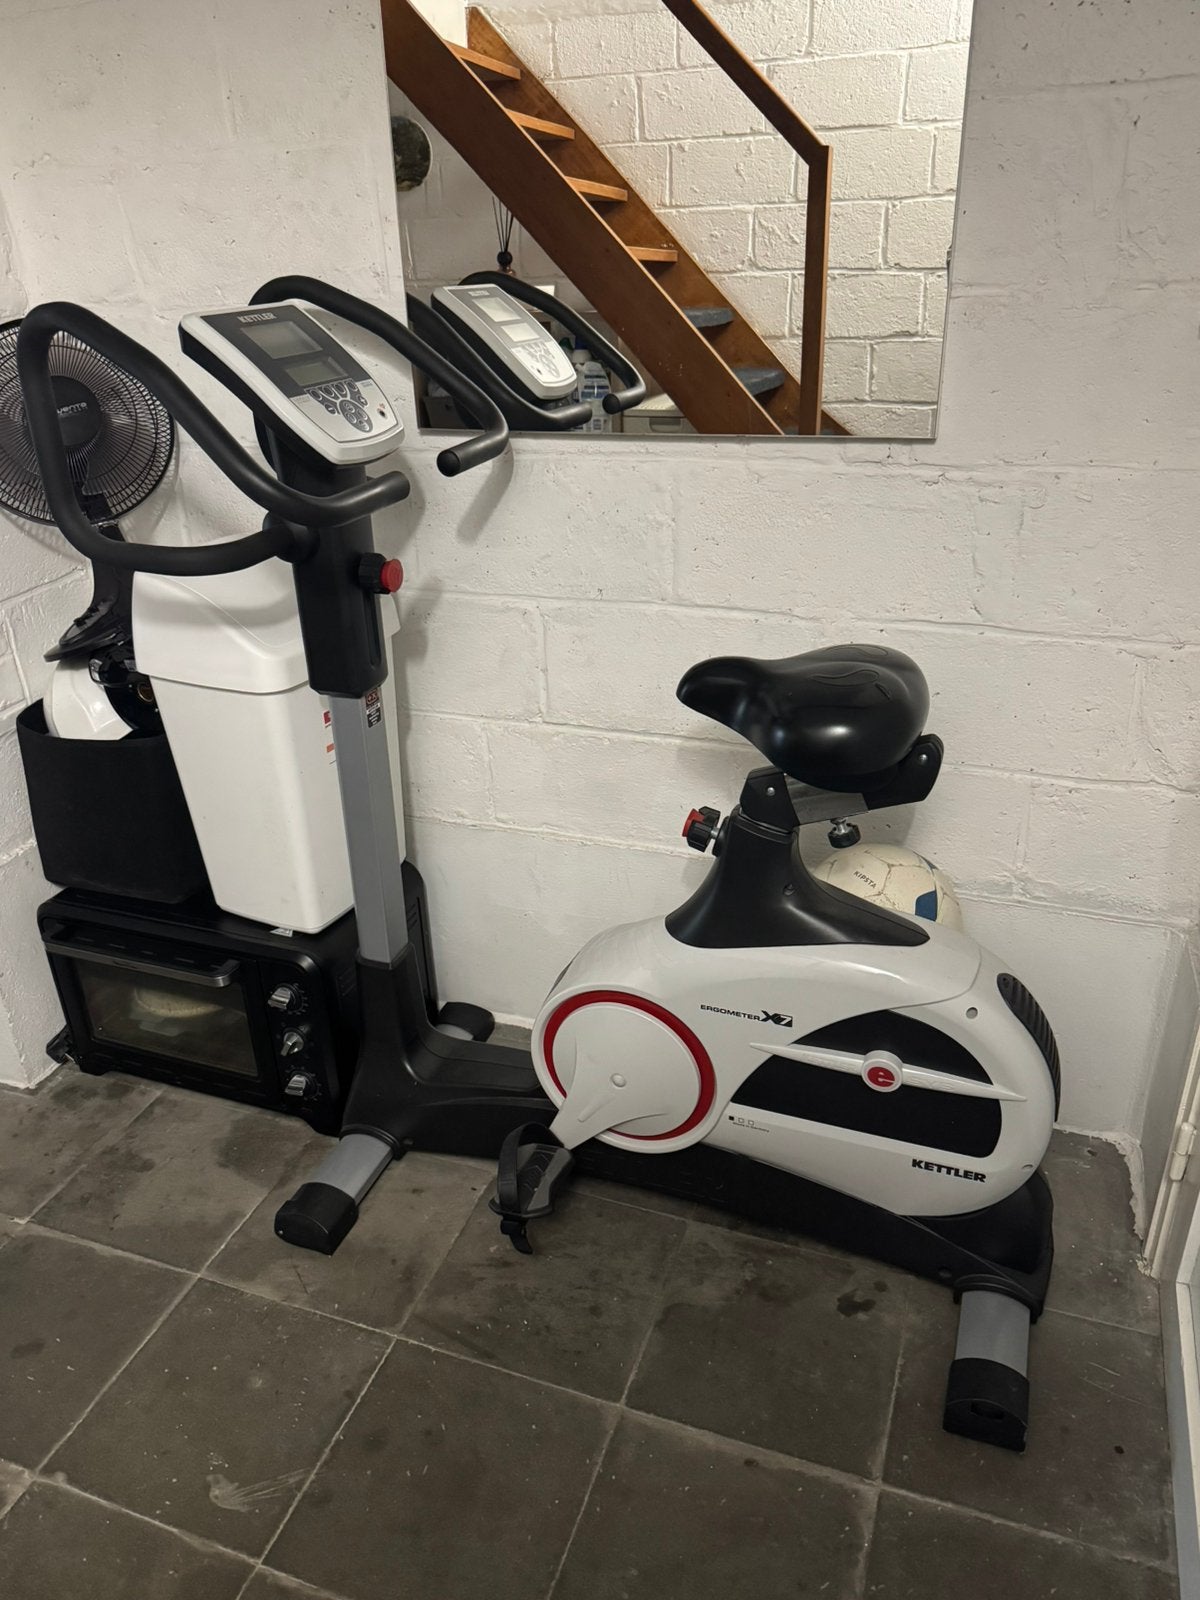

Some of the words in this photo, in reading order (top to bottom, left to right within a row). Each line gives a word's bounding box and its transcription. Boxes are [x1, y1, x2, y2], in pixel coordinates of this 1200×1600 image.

[237, 312, 277, 323] KETTLER
[853, 870, 877, 889] KIPSTA
[700, 1004, 761, 1022] ERGOMETER
[911, 1158, 987, 1183] KETTLER
